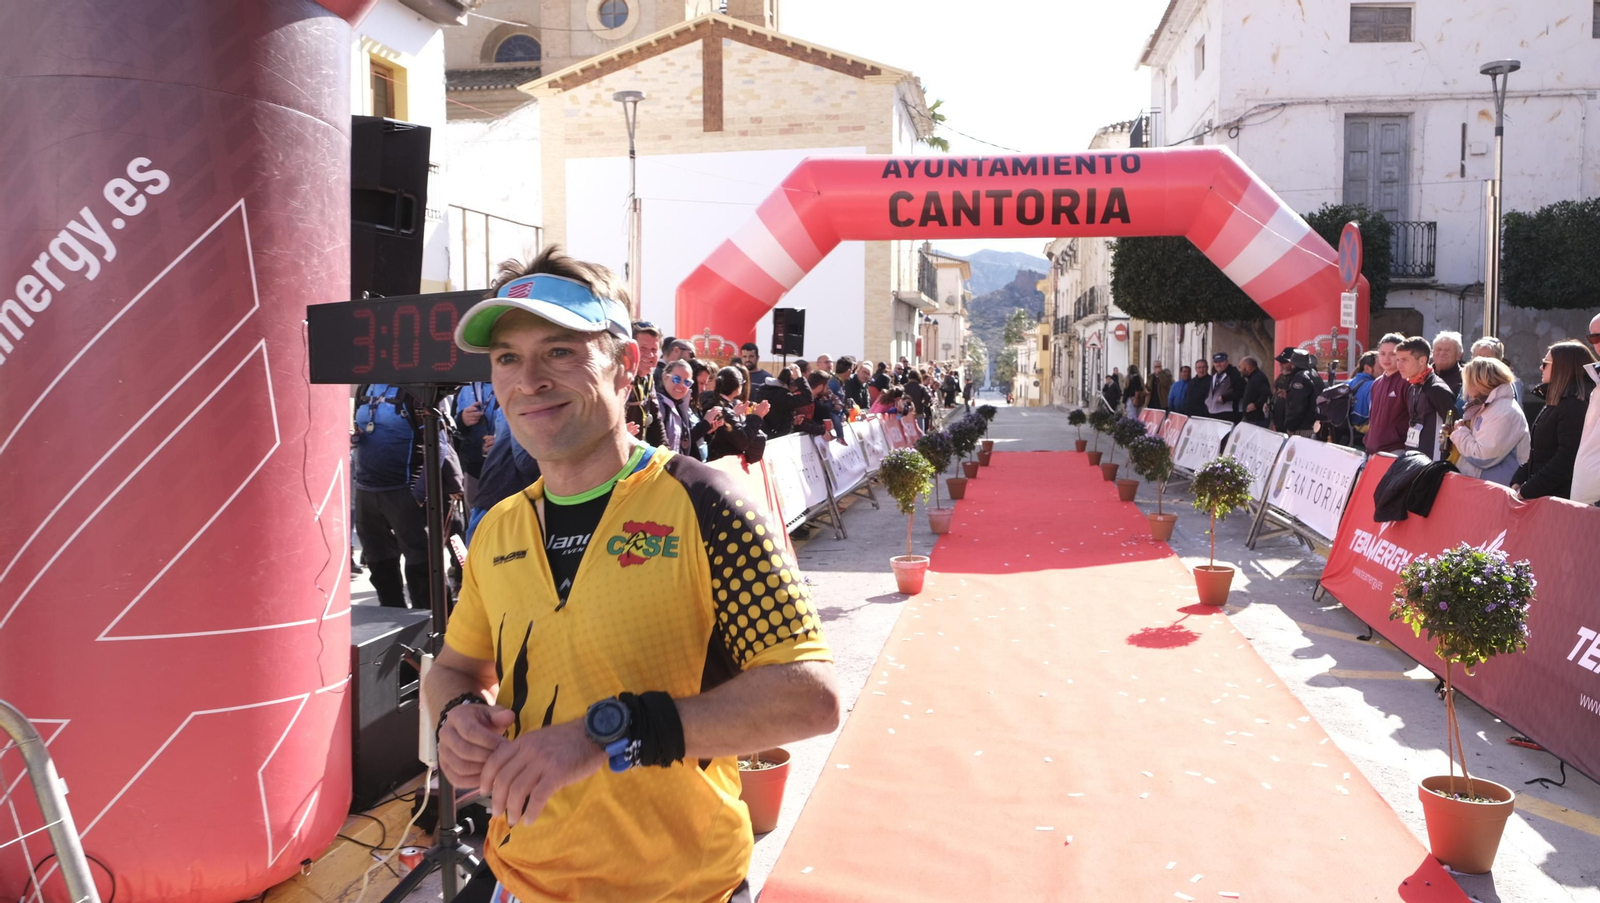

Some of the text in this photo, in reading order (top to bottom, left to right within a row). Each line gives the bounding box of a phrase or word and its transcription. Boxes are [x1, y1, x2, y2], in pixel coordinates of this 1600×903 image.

[881, 152, 1141, 178] AYUNTAMIENTO
[888, 187, 1131, 228] CANTORIA
[0, 156, 171, 366] mergy.es
[1285, 470, 1344, 517] CANTORIA
[1349, 528, 1413, 575] TEAMERGY
[1566, 626, 1600, 674] TE
